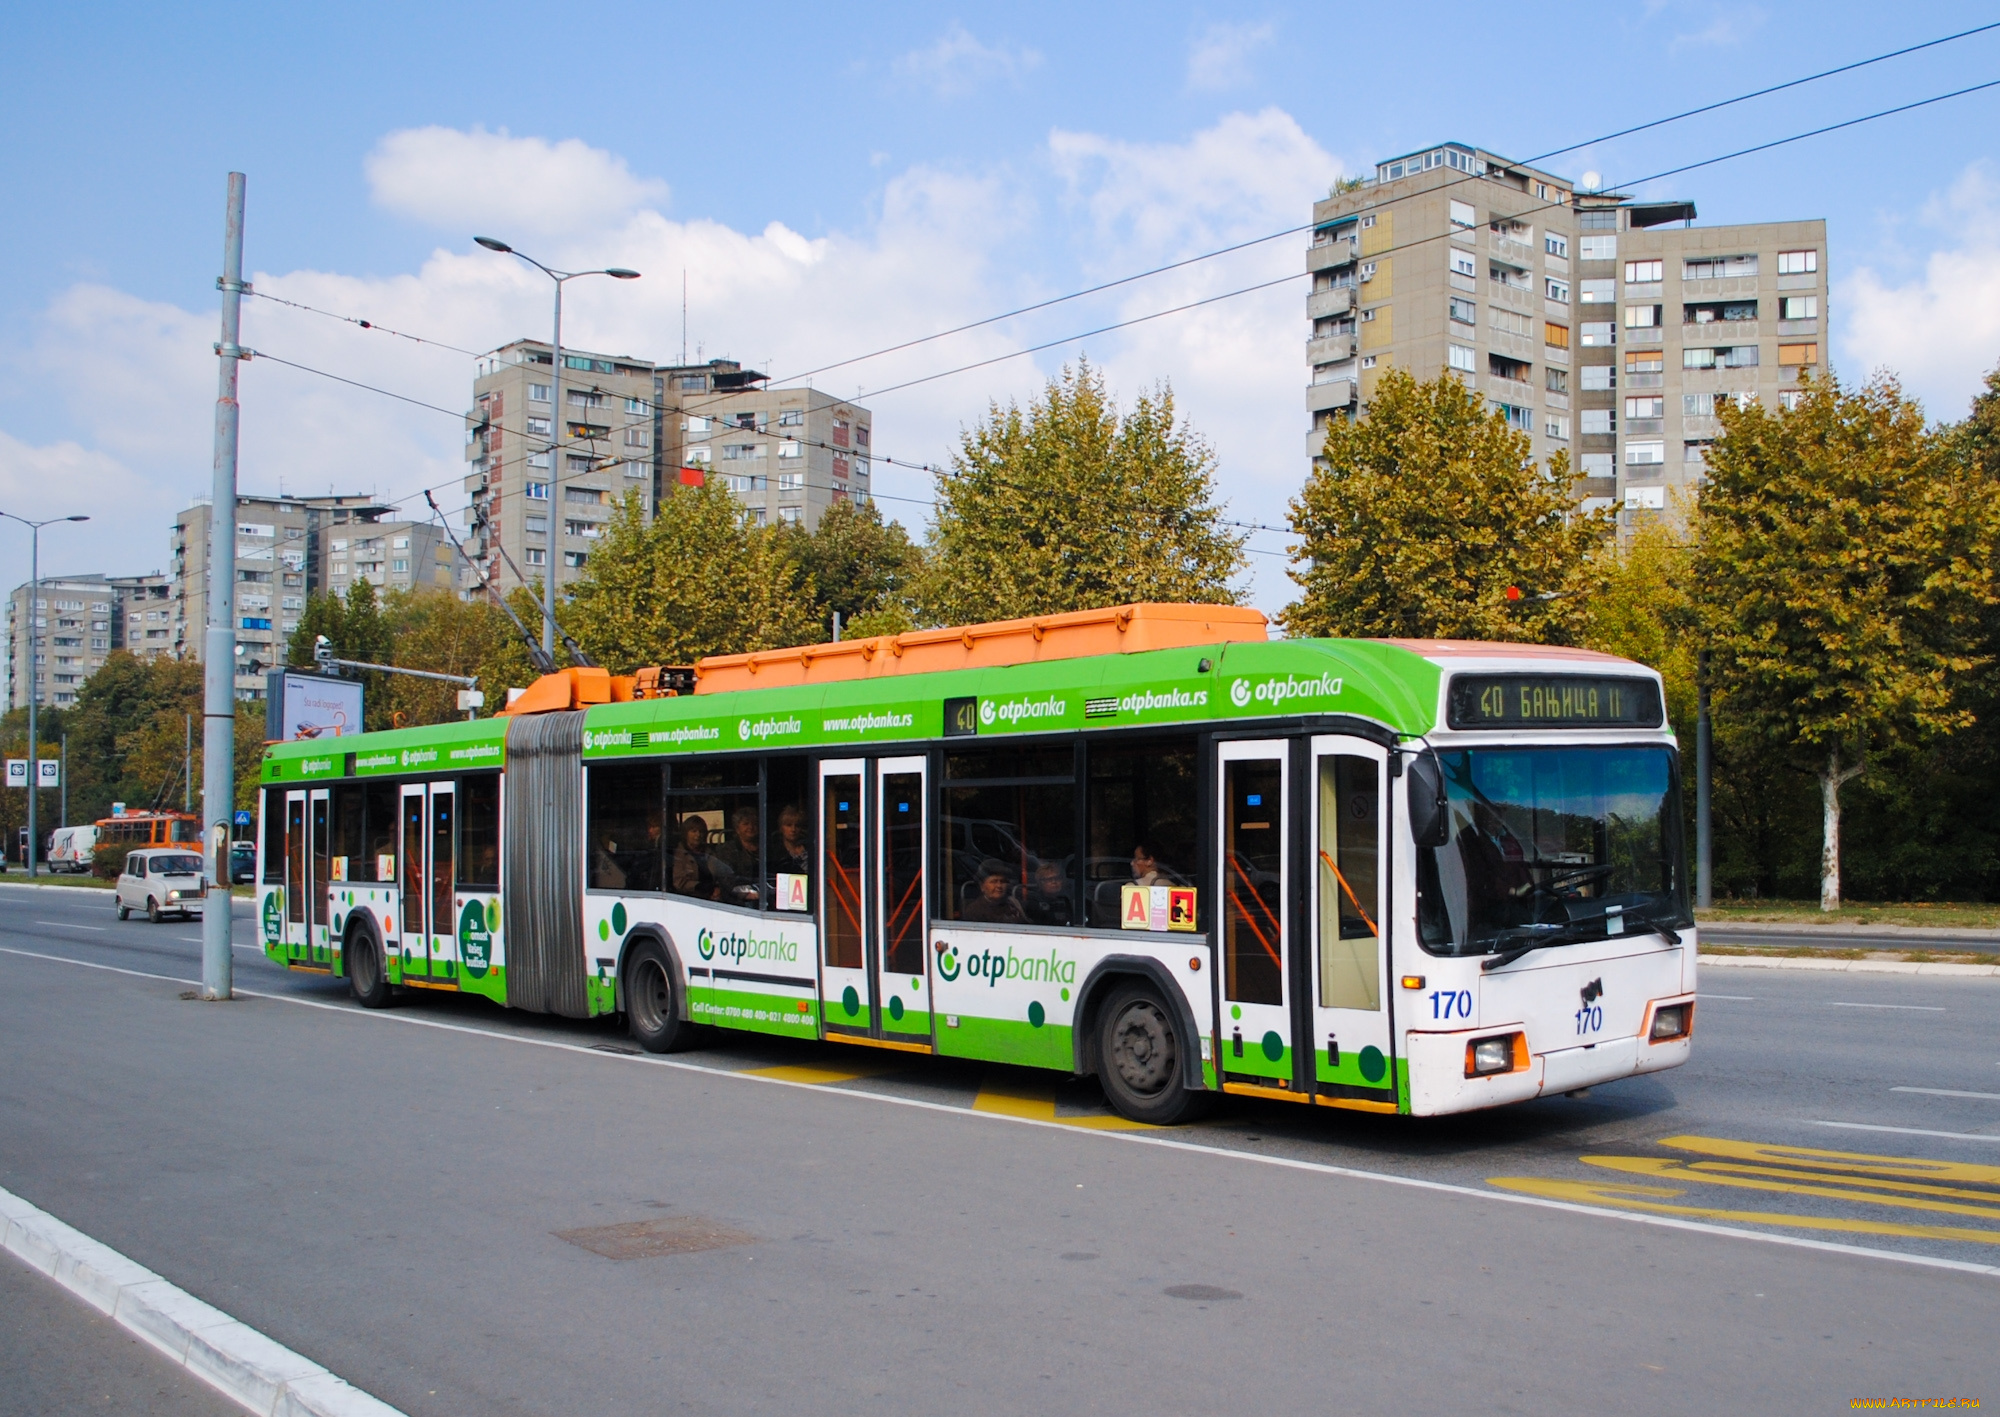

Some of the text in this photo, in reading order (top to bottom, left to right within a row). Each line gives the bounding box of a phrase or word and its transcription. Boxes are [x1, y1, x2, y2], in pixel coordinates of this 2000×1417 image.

[1255, 672, 1343, 706] otpbanka
[1480, 685, 1503, 718] 40
[1520, 686, 1598, 719] БАЊИЦА
[823, 711, 913, 733] www.otpbanka.rs
[957, 703, 975, 731] 40
[998, 694, 1065, 725] otpbanka
[594, 728, 632, 750] otpbanka
[650, 725, 719, 745] www.otpbanka.rs
[752, 715, 801, 740] otpbanka
[450, 744, 500, 761] www.otpbanka.rs
[386, 858, 393, 876] A
[791, 879, 805, 904] A
[1126, 891, 1147, 922] A
[720, 929, 798, 966] otpbanka
[966, 945, 1077, 988] otpbanka
[725, 1006, 740, 1017] 0700
[801, 1015, 815, 1026] 400
[1428, 989, 1472, 1019] 170
[1574, 1005, 1603, 1036] 170
